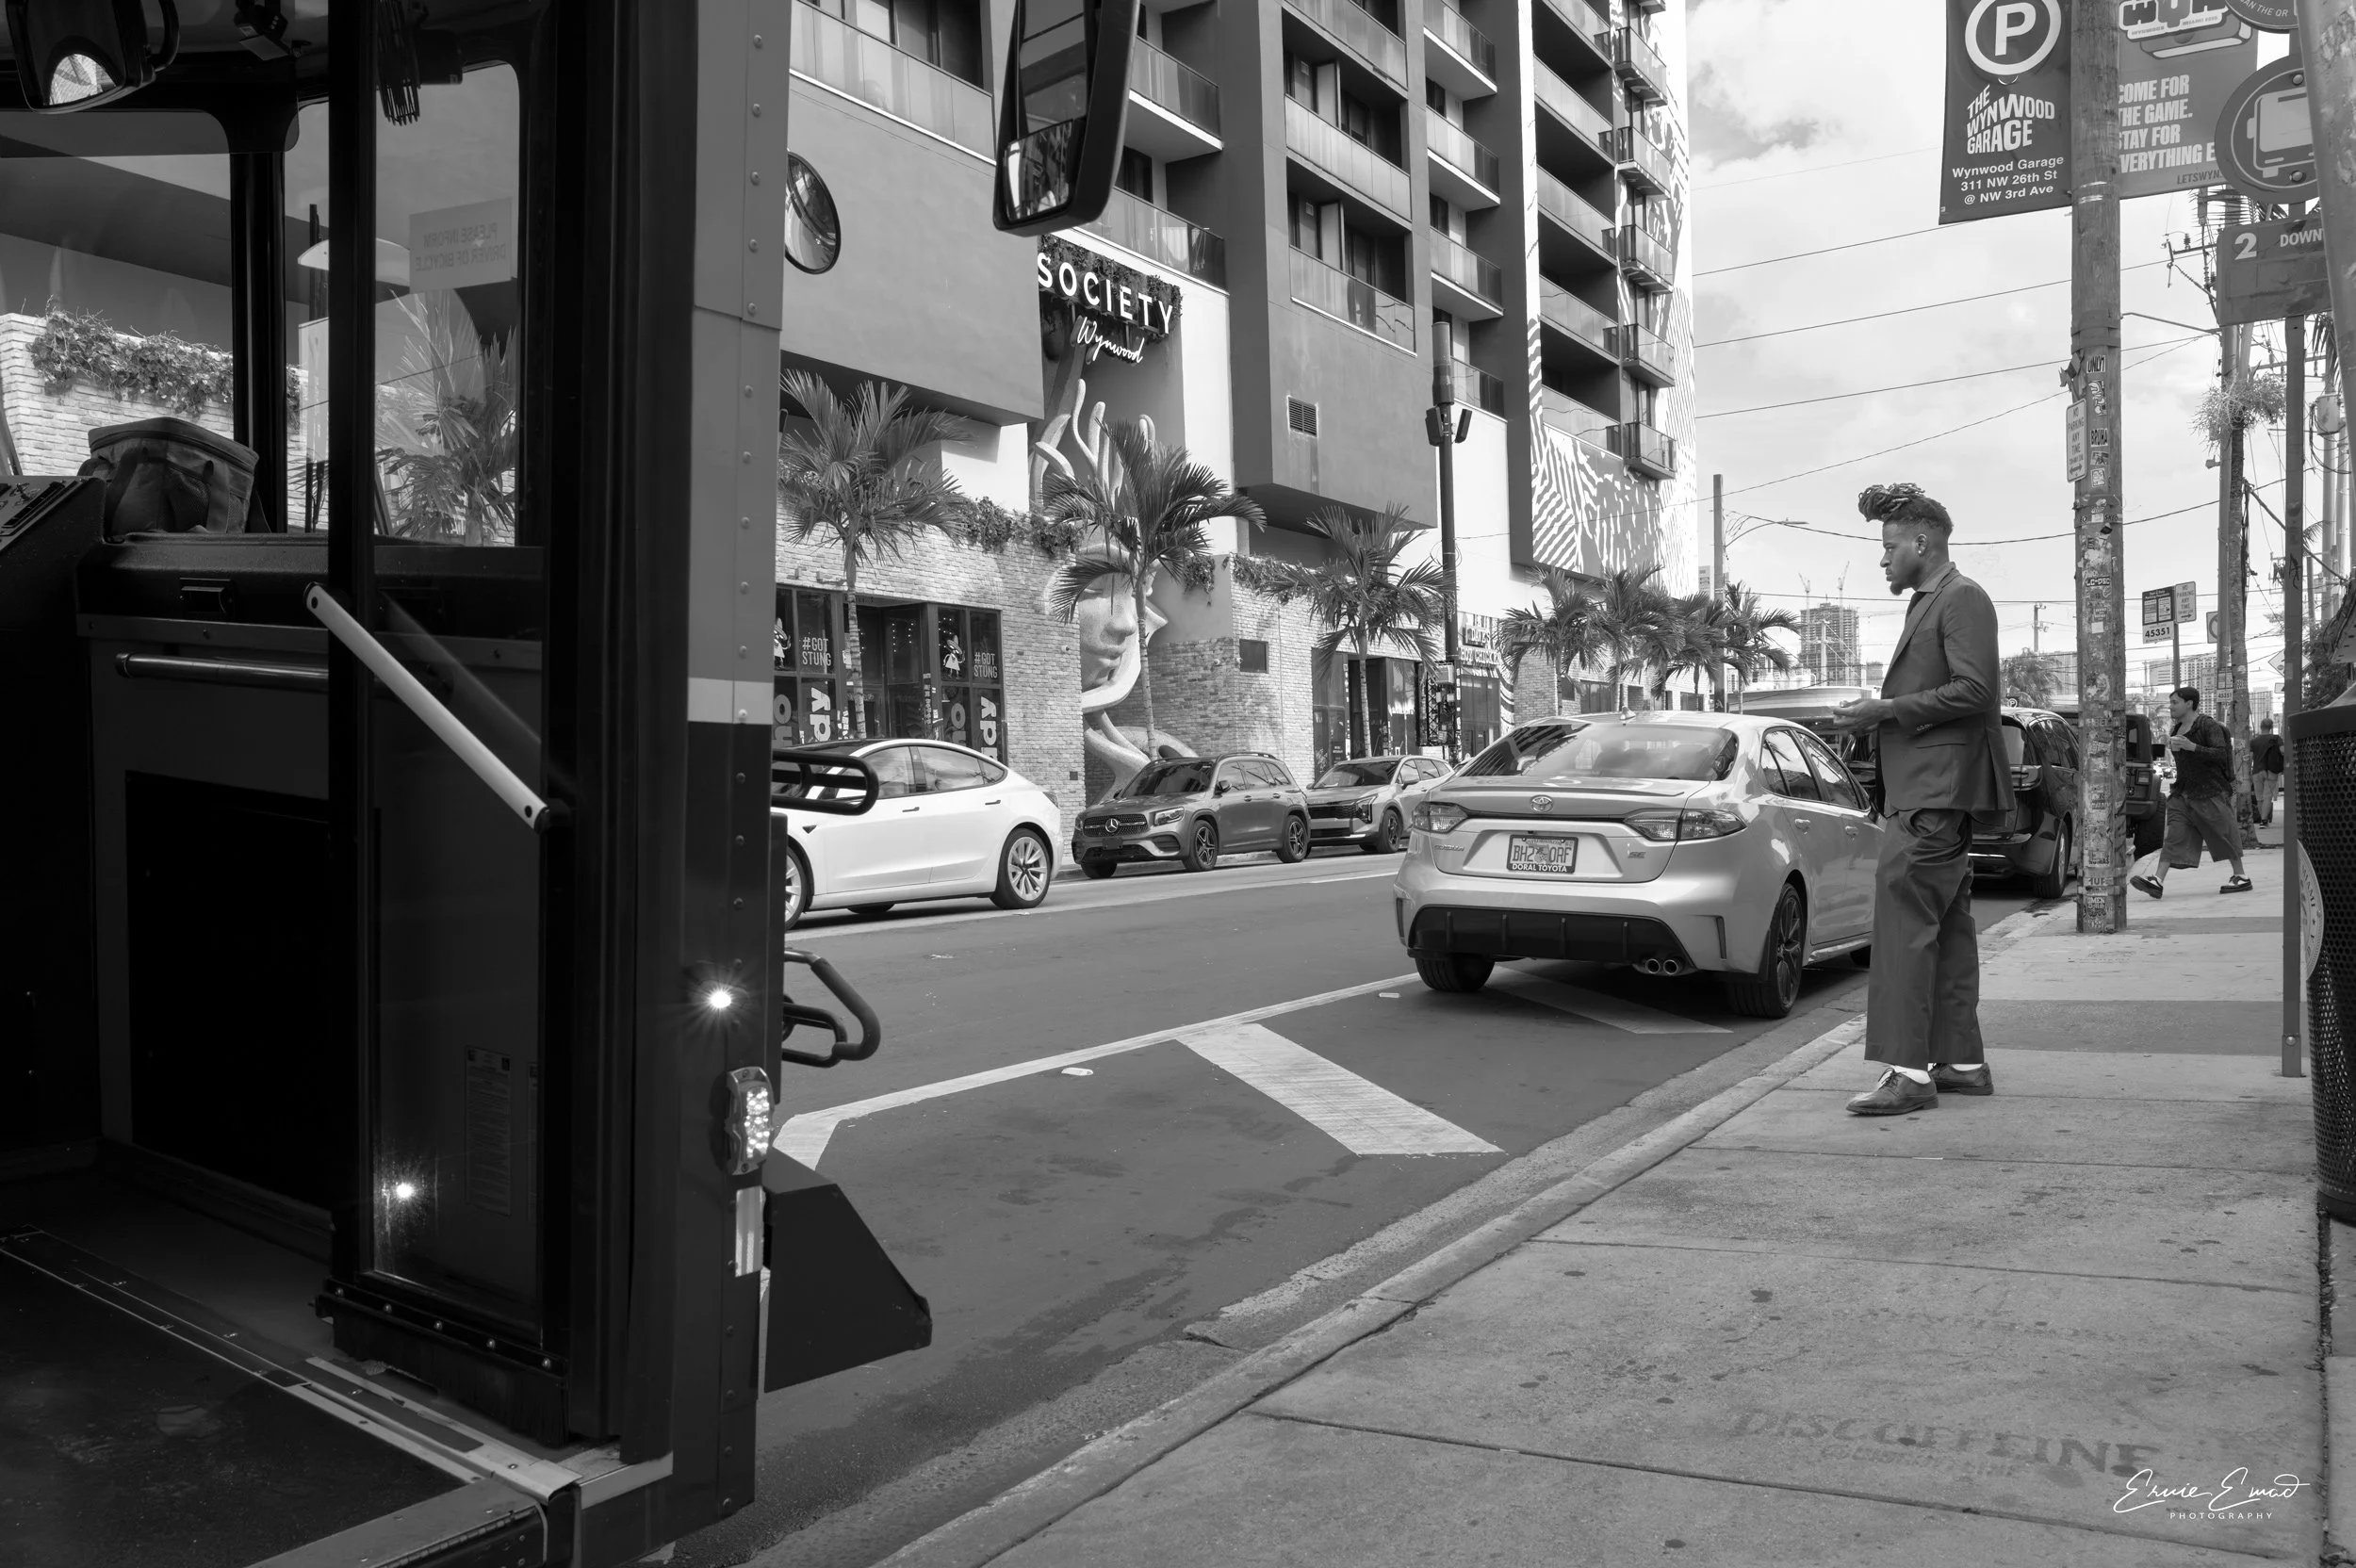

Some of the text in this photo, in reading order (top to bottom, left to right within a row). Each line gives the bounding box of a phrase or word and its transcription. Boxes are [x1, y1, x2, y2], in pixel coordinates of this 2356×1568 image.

[2256, 5, 2274, 16] THE
[1995, 2, 2036, 56] P
[2160, 74, 2190, 99] FOR
[1967, 84, 1990, 120] THE
[2144, 98, 2193, 124] GAME.
[1966, 93, 2055, 139] WYNWOOD
[1967, 119, 2033, 155] GARAGE
[2151, 124, 2181, 147] FOR
[1953, 155, 2065, 179] Wynwood Garage
[1961, 170, 2058, 191] 311 NW 26th St
[1964, 185, 2054, 204] @ NW 3rd Ave
[2234, 232, 2258, 260] 2
[1037, 252, 1173, 335] SOCIETY
[1076, 316, 1145, 364] Wynwood
[2145, 627, 2170, 638] 45351
[802, 650, 831, 666] STUNG
[973, 664, 998, 678] STUNG
[1538, 864, 1567, 873] TOYOTA
